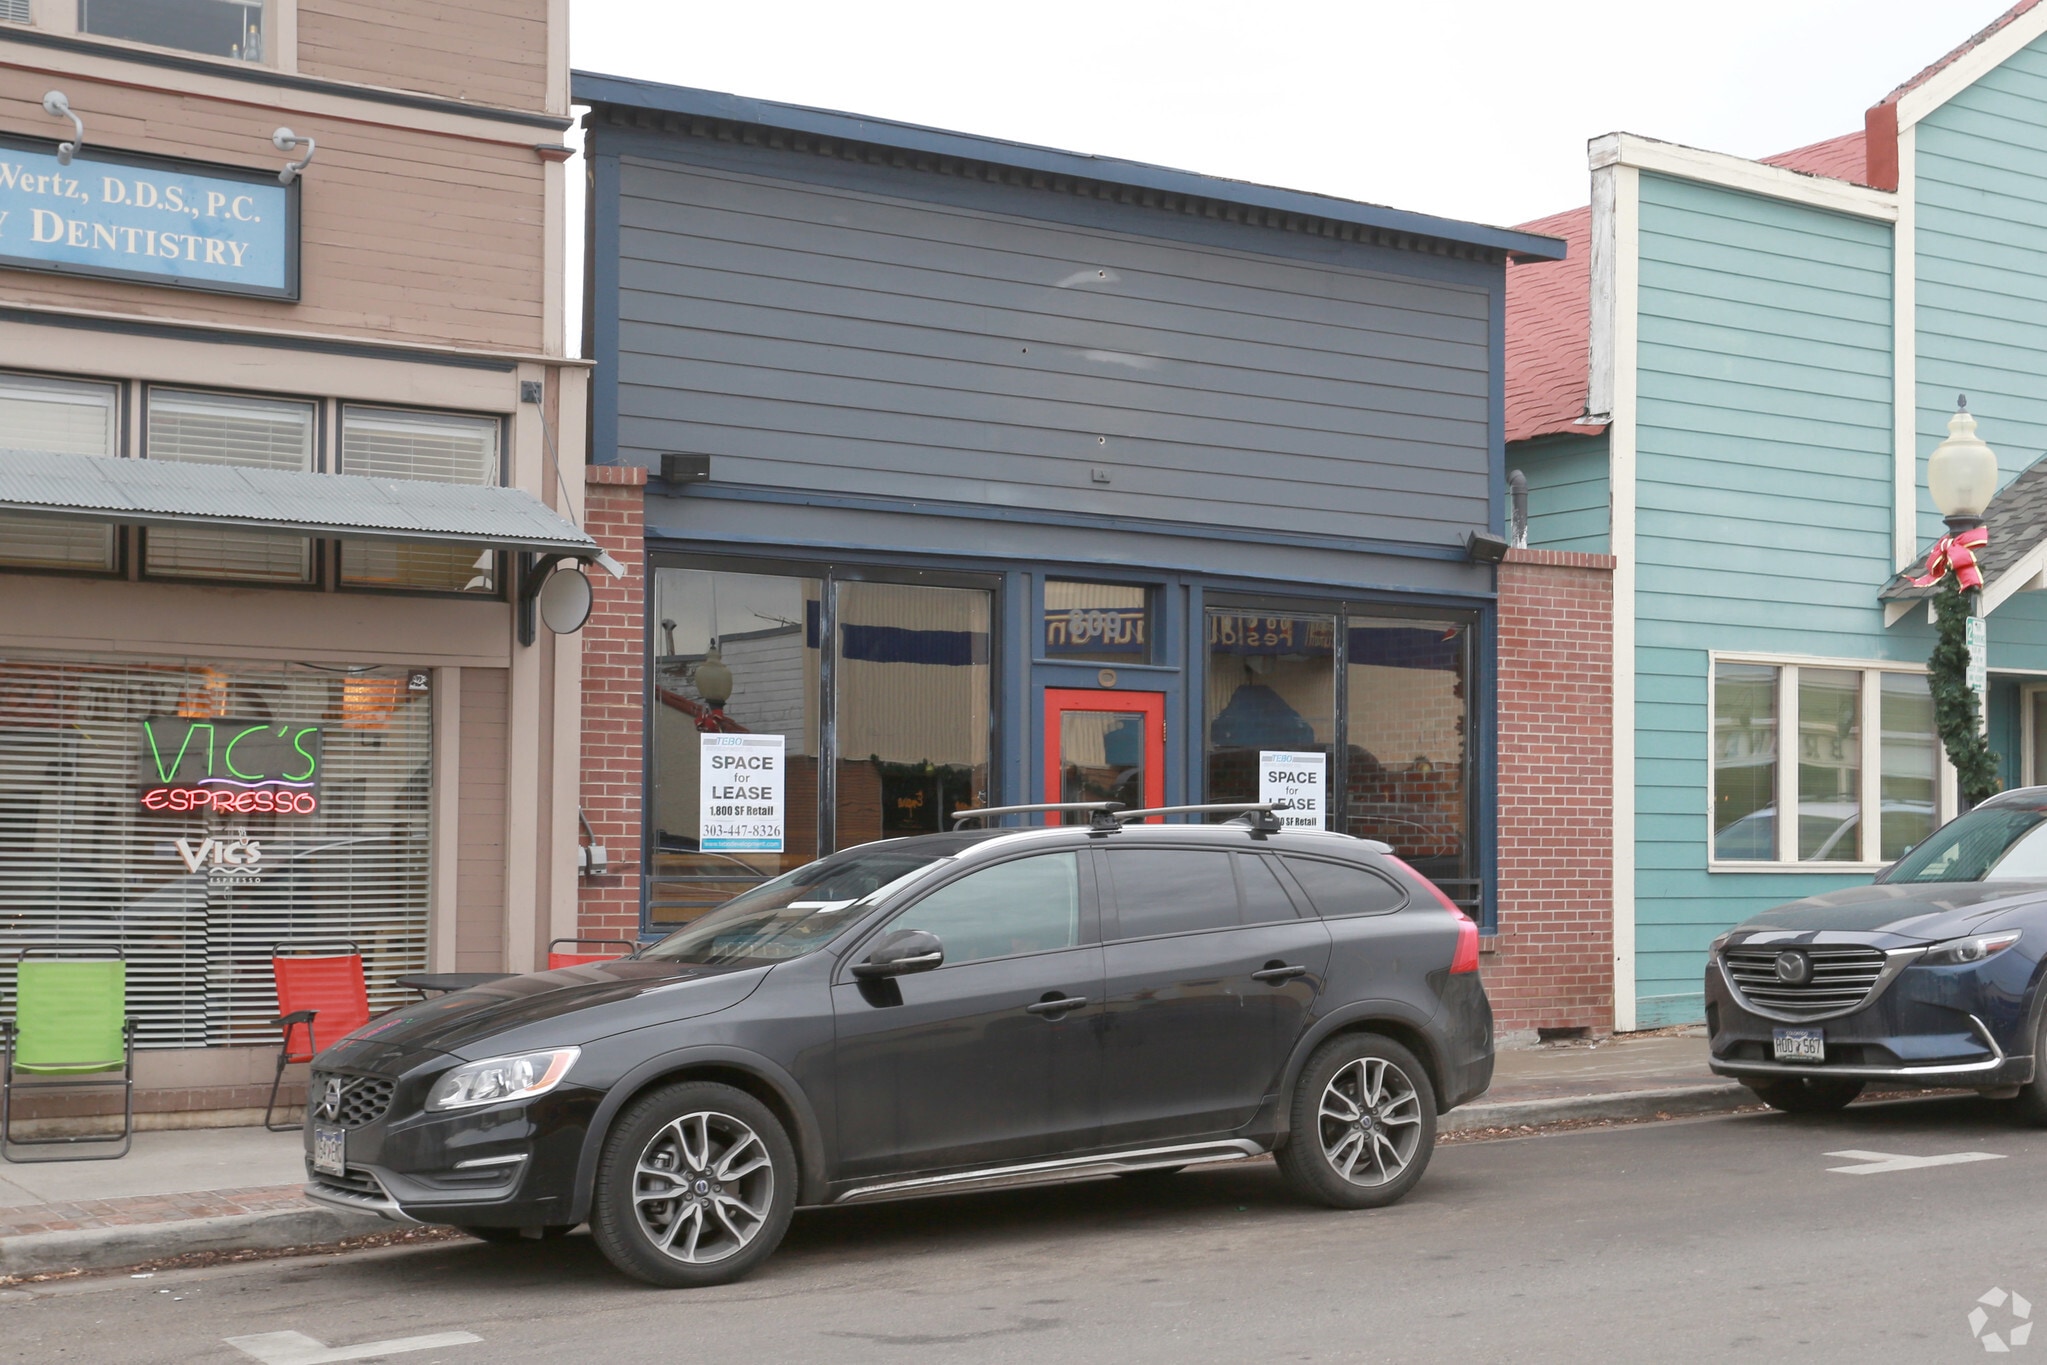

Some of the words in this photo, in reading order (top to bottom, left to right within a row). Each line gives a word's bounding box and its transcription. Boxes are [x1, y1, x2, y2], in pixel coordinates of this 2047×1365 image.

[0, 162, 90, 204] Wertz,
[101, 176, 199, 219] D.D.S.,
[206, 191, 261, 223] P.C.
[30, 208, 249, 268] DENTISTRY
[716, 737, 743, 746] TEBO
[143, 721, 318, 783] VIC'S
[711, 755, 774, 770] SPACE
[734, 772, 750, 783] for
[1268, 771, 1317, 784] SPACE
[712, 786, 772, 800] LEASE
[1286, 786, 1298, 795] for
[141, 788, 316, 814] ESPRESSO
[734, 806, 745, 816] SF
[746, 806, 774, 816] Retail
[1286, 817, 1294, 826] SF
[1295, 817, 1317, 826] Retail
[703, 824, 781, 837] 303-447-8326
